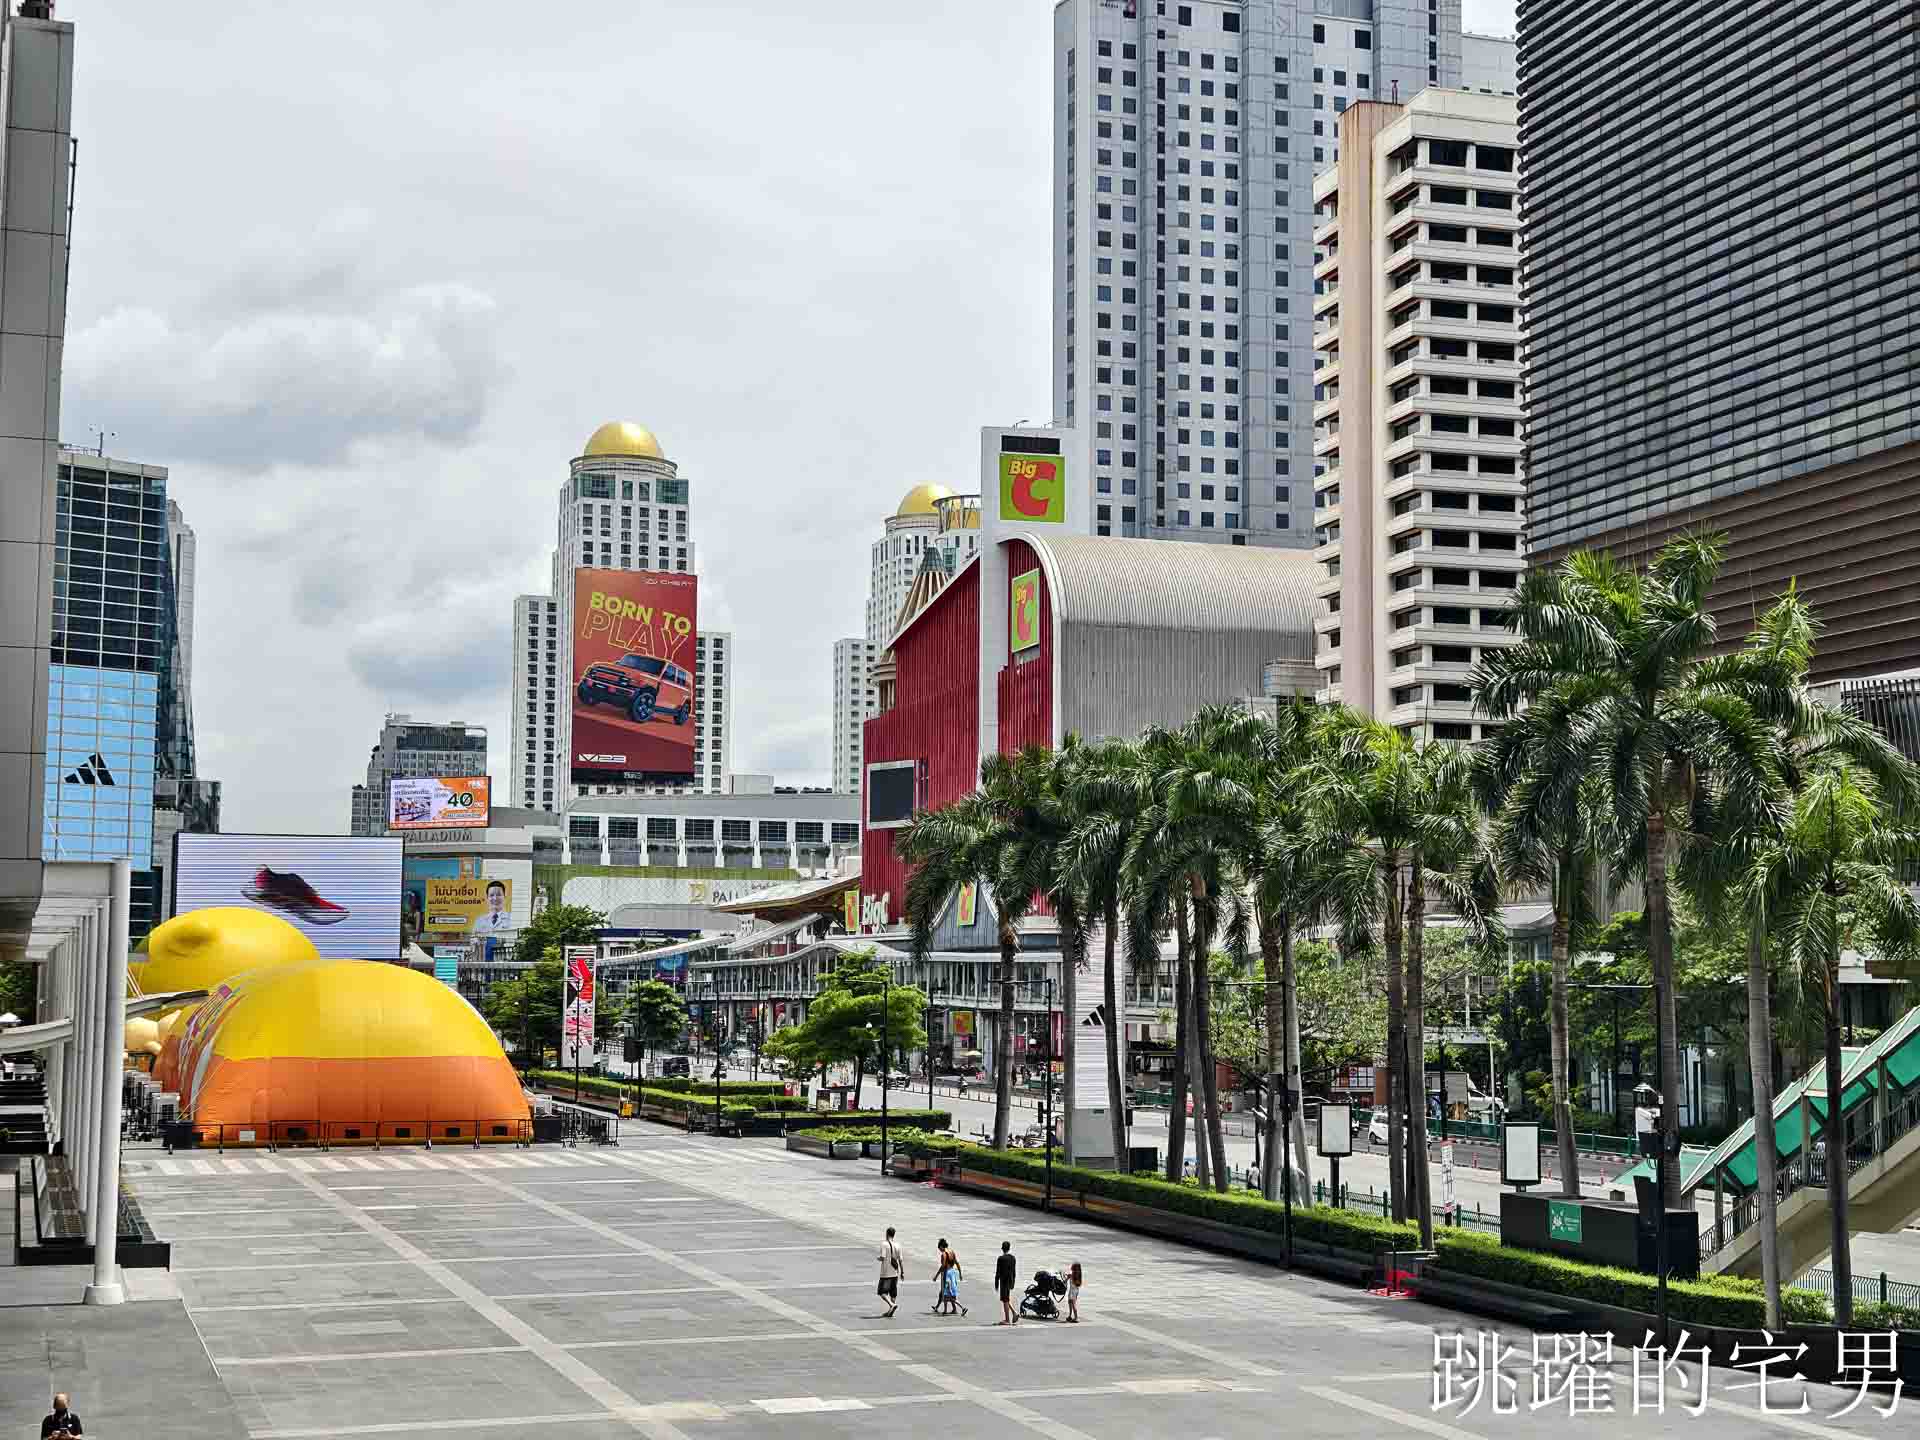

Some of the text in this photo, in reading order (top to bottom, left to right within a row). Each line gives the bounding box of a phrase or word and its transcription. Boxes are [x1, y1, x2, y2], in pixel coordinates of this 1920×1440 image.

[1008, 460, 1037, 480] Big
[591, 592, 691, 635] BORN TO
[582, 607, 689, 662] PLAY
[402, 831, 473, 843] PALLADIUM
